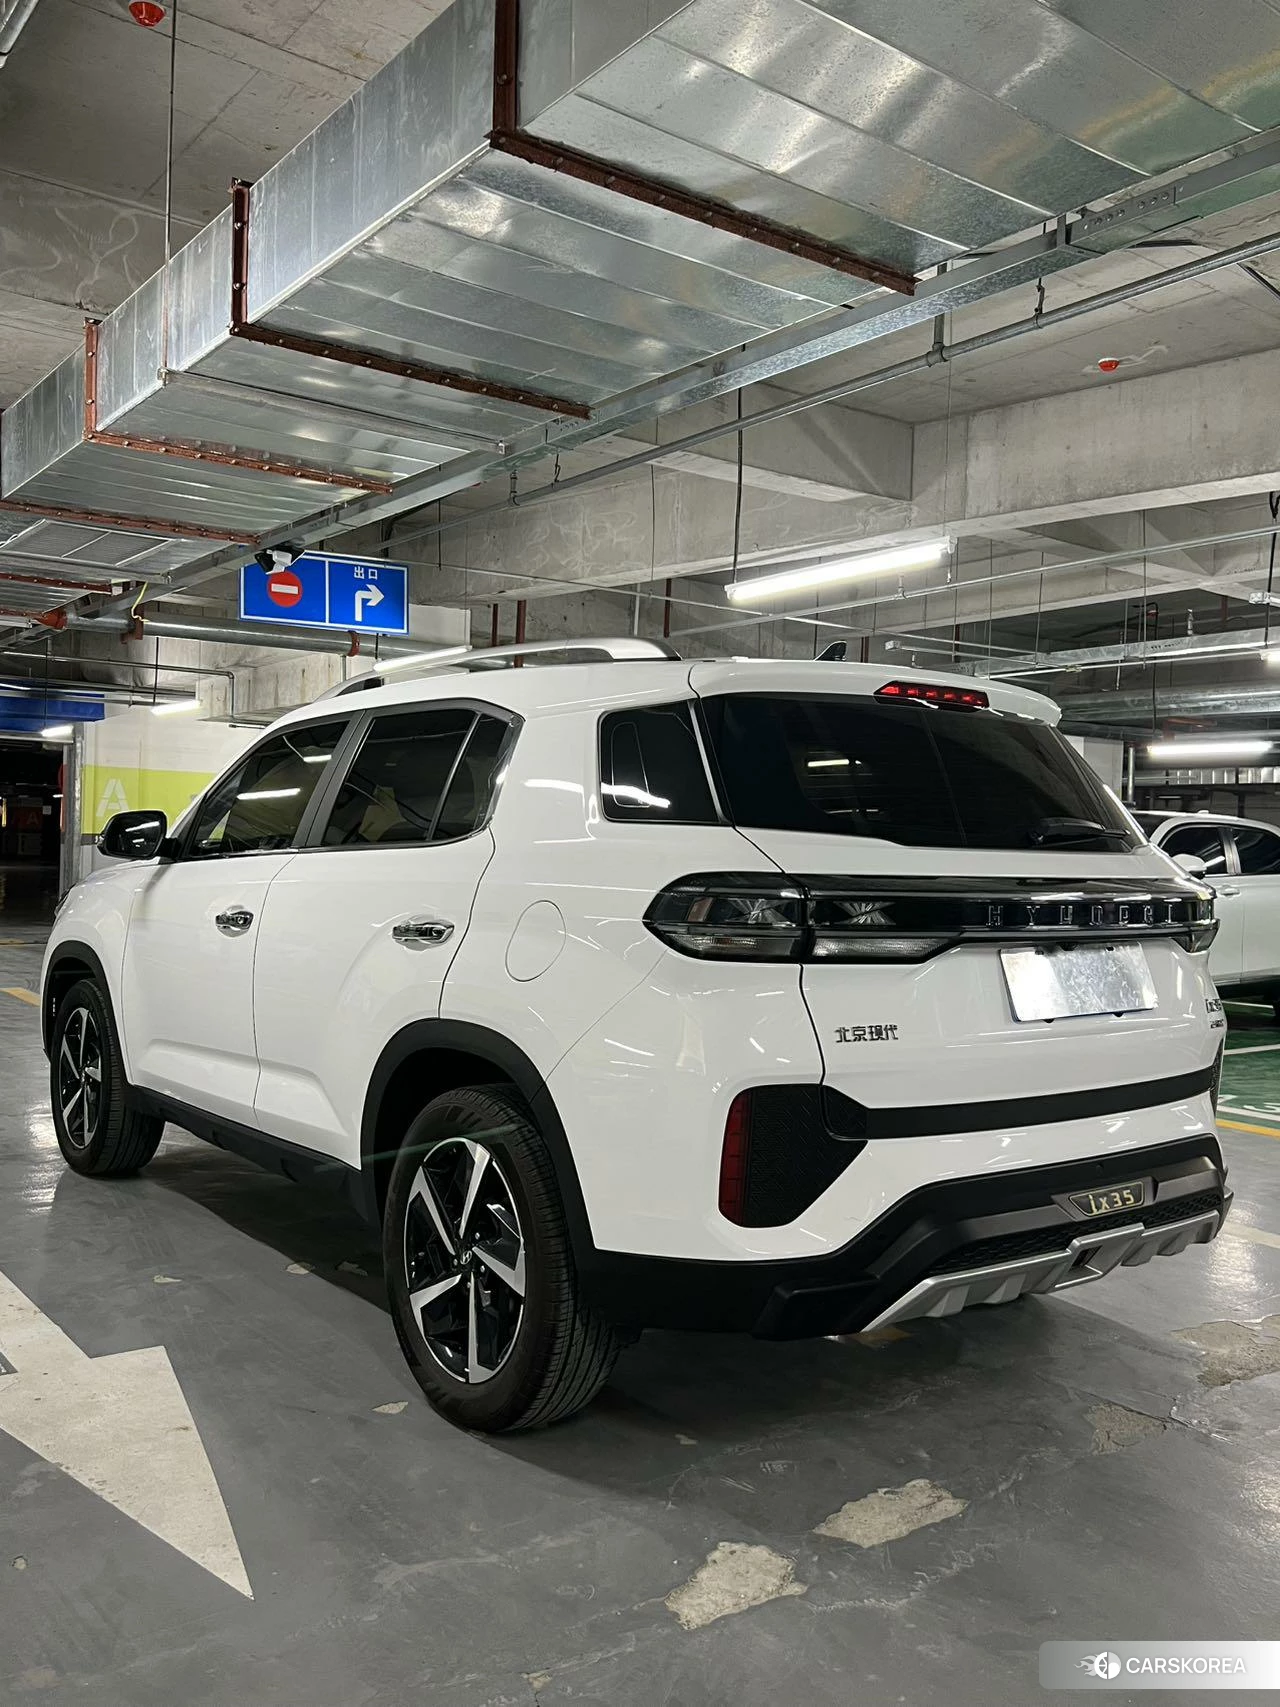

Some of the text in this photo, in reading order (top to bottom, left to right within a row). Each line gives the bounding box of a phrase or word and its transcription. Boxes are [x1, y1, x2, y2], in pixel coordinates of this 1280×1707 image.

[353, 565, 378, 580] 出口
[95, 778, 129, 817] A
[834, 1024, 899, 1043] 北京现代
[1088, 1189, 1135, 1214] ix35
